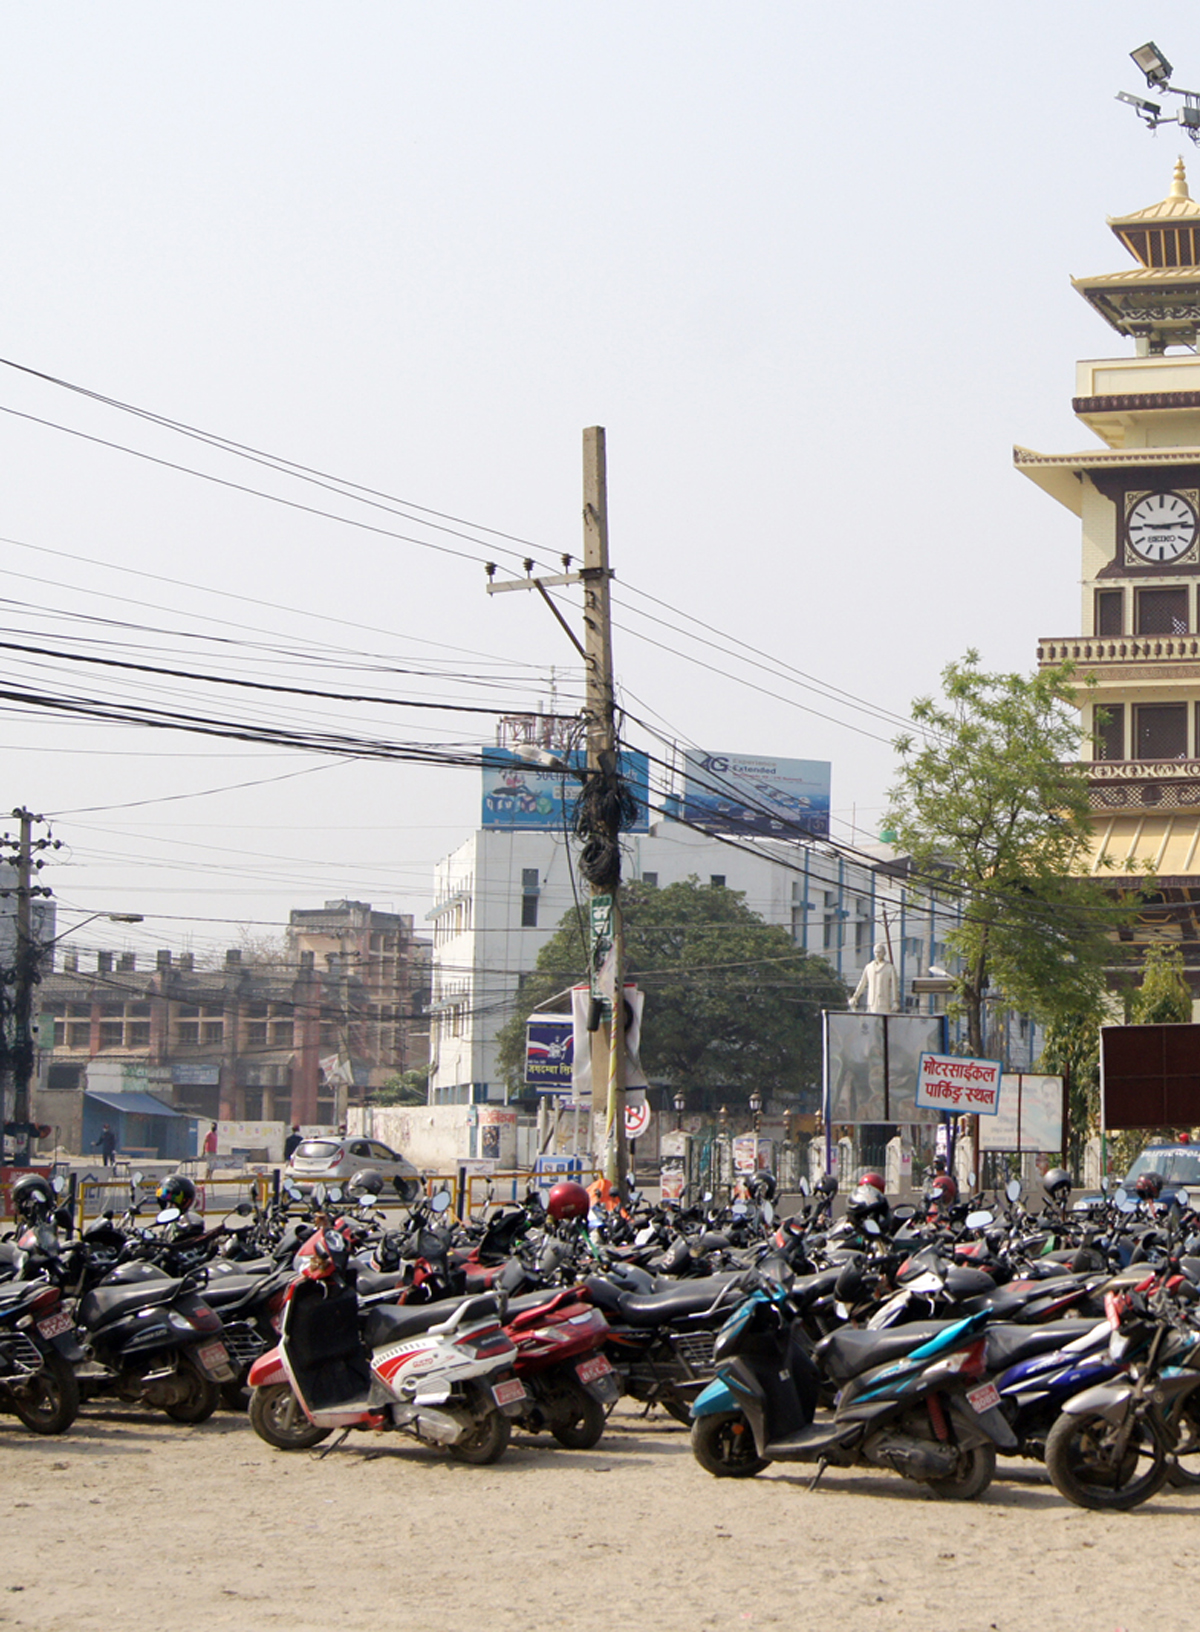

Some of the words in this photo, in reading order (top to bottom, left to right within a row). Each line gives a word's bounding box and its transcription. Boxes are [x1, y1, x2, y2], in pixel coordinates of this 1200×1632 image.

[1148, 535, 1176, 543] SEIKO
[732, 765, 776, 775] Extended
[923, 1056, 996, 1082] मोटरसाईकल
[965, 1086, 995, 1104] स्थल
